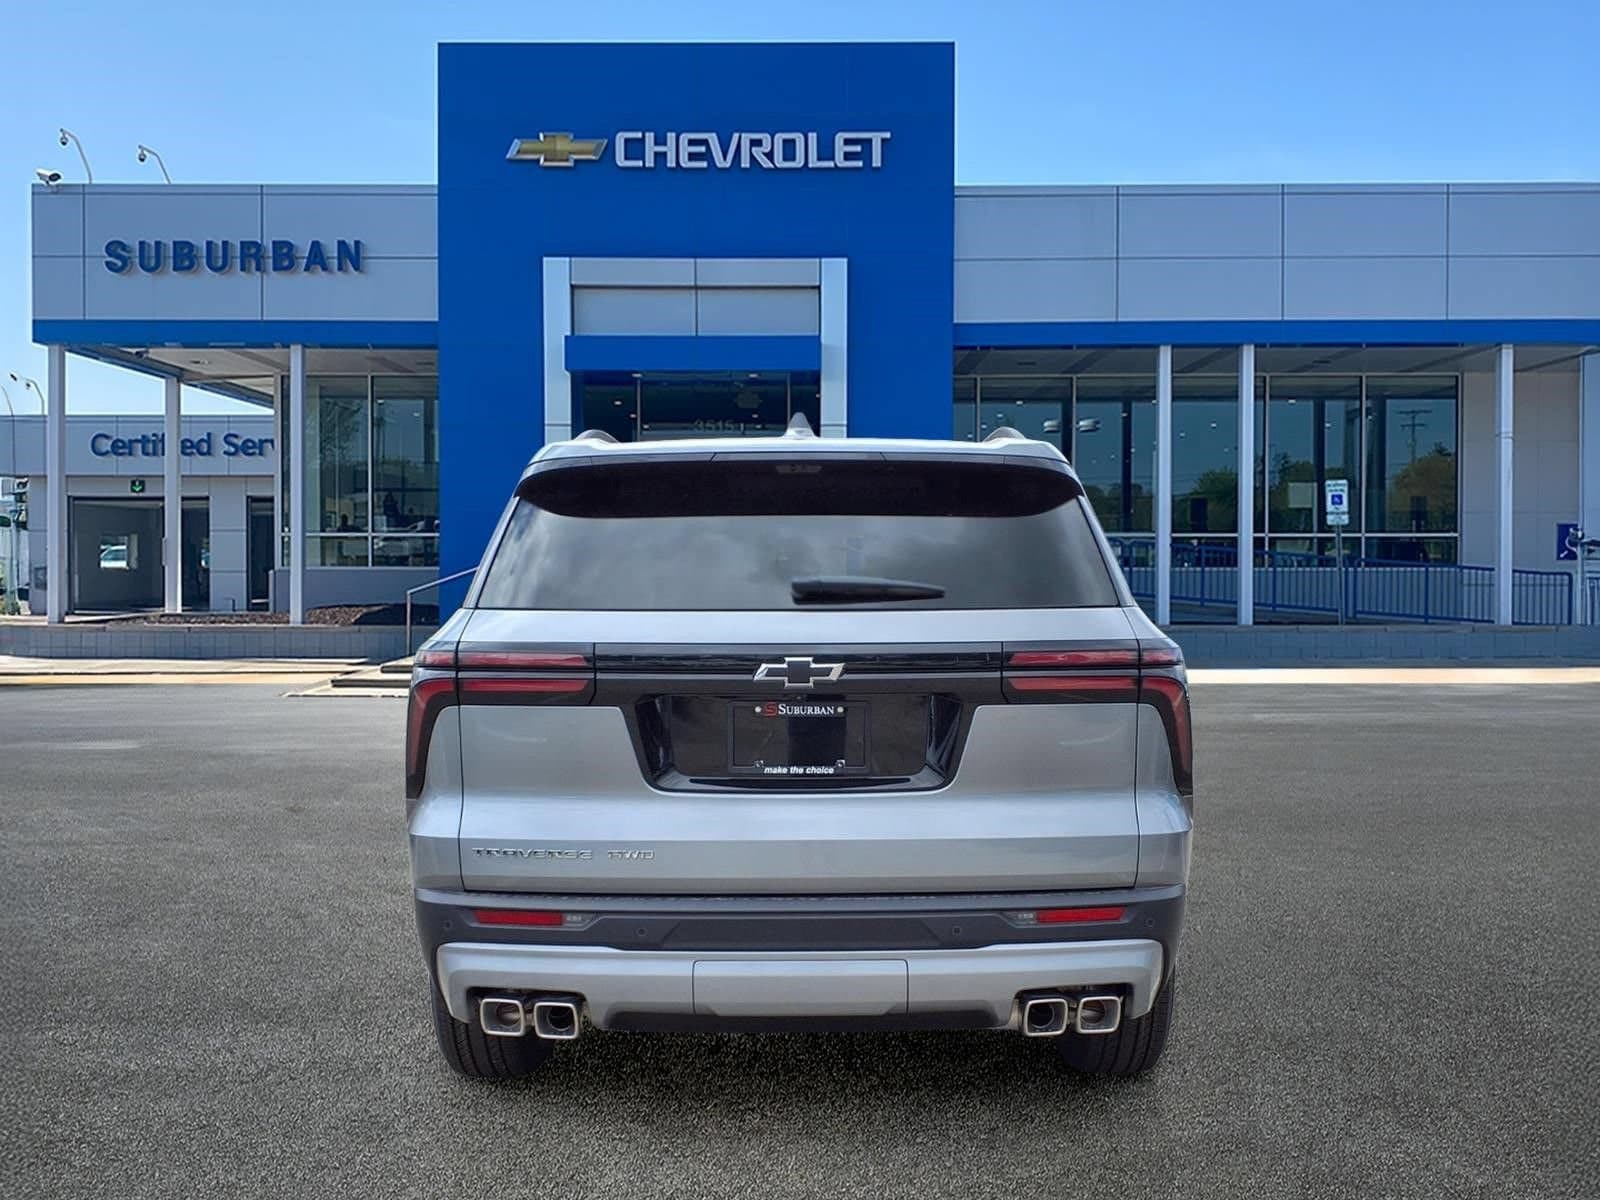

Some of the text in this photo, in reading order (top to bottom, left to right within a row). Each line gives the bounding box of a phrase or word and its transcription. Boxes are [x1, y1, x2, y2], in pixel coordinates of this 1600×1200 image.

[615, 131, 891, 168] CHEVROLET
[104, 239, 362, 274] SUBURBAN
[764, 765, 834, 774] make the choice
[472, 847, 593, 860] TRAVERSE
